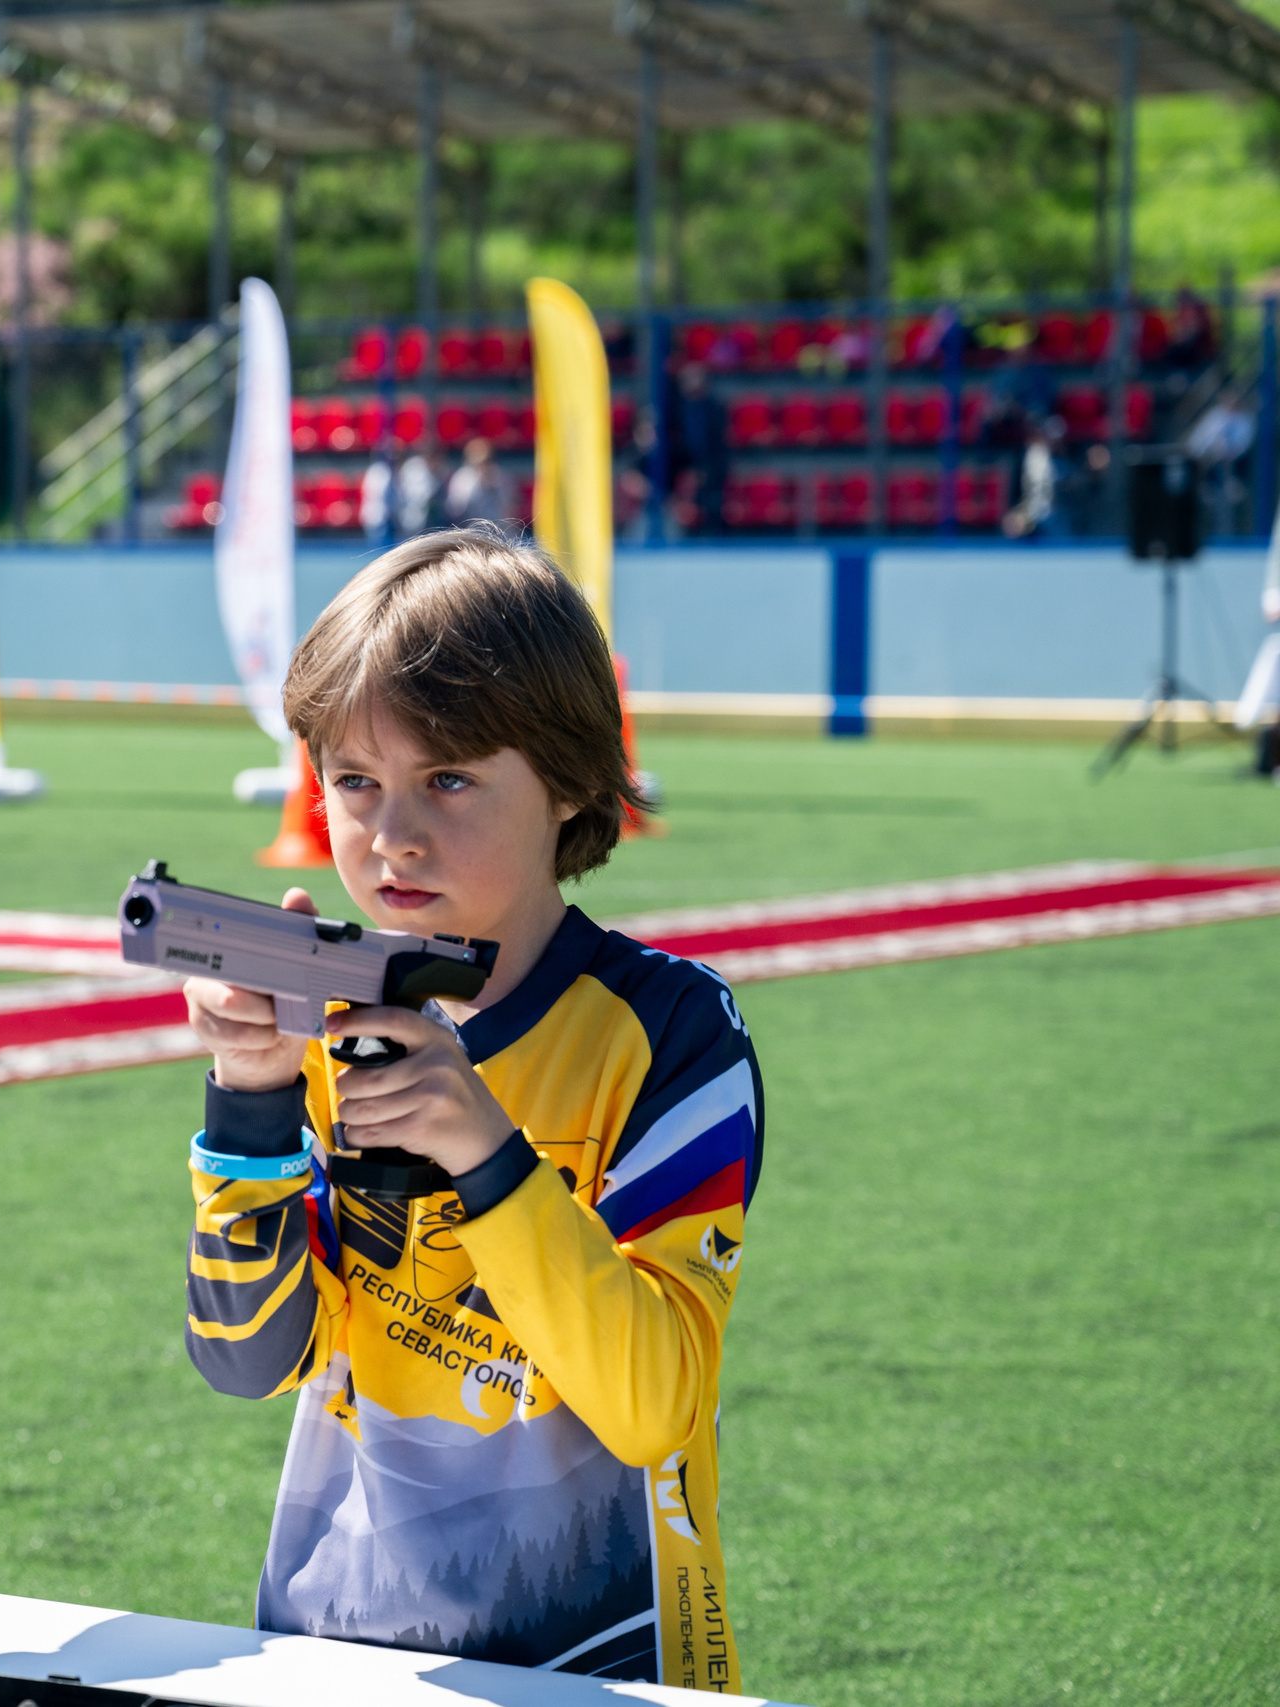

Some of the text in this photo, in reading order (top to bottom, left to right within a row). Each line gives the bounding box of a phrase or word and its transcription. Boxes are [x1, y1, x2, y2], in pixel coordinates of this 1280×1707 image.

[348, 1263, 493, 1354] РЕСПУБЛИКА
[386, 1320, 537, 1406] СЕВАСТОПОЬ
[677, 1567, 694, 1666] ПОКОЛЕНИЕ
